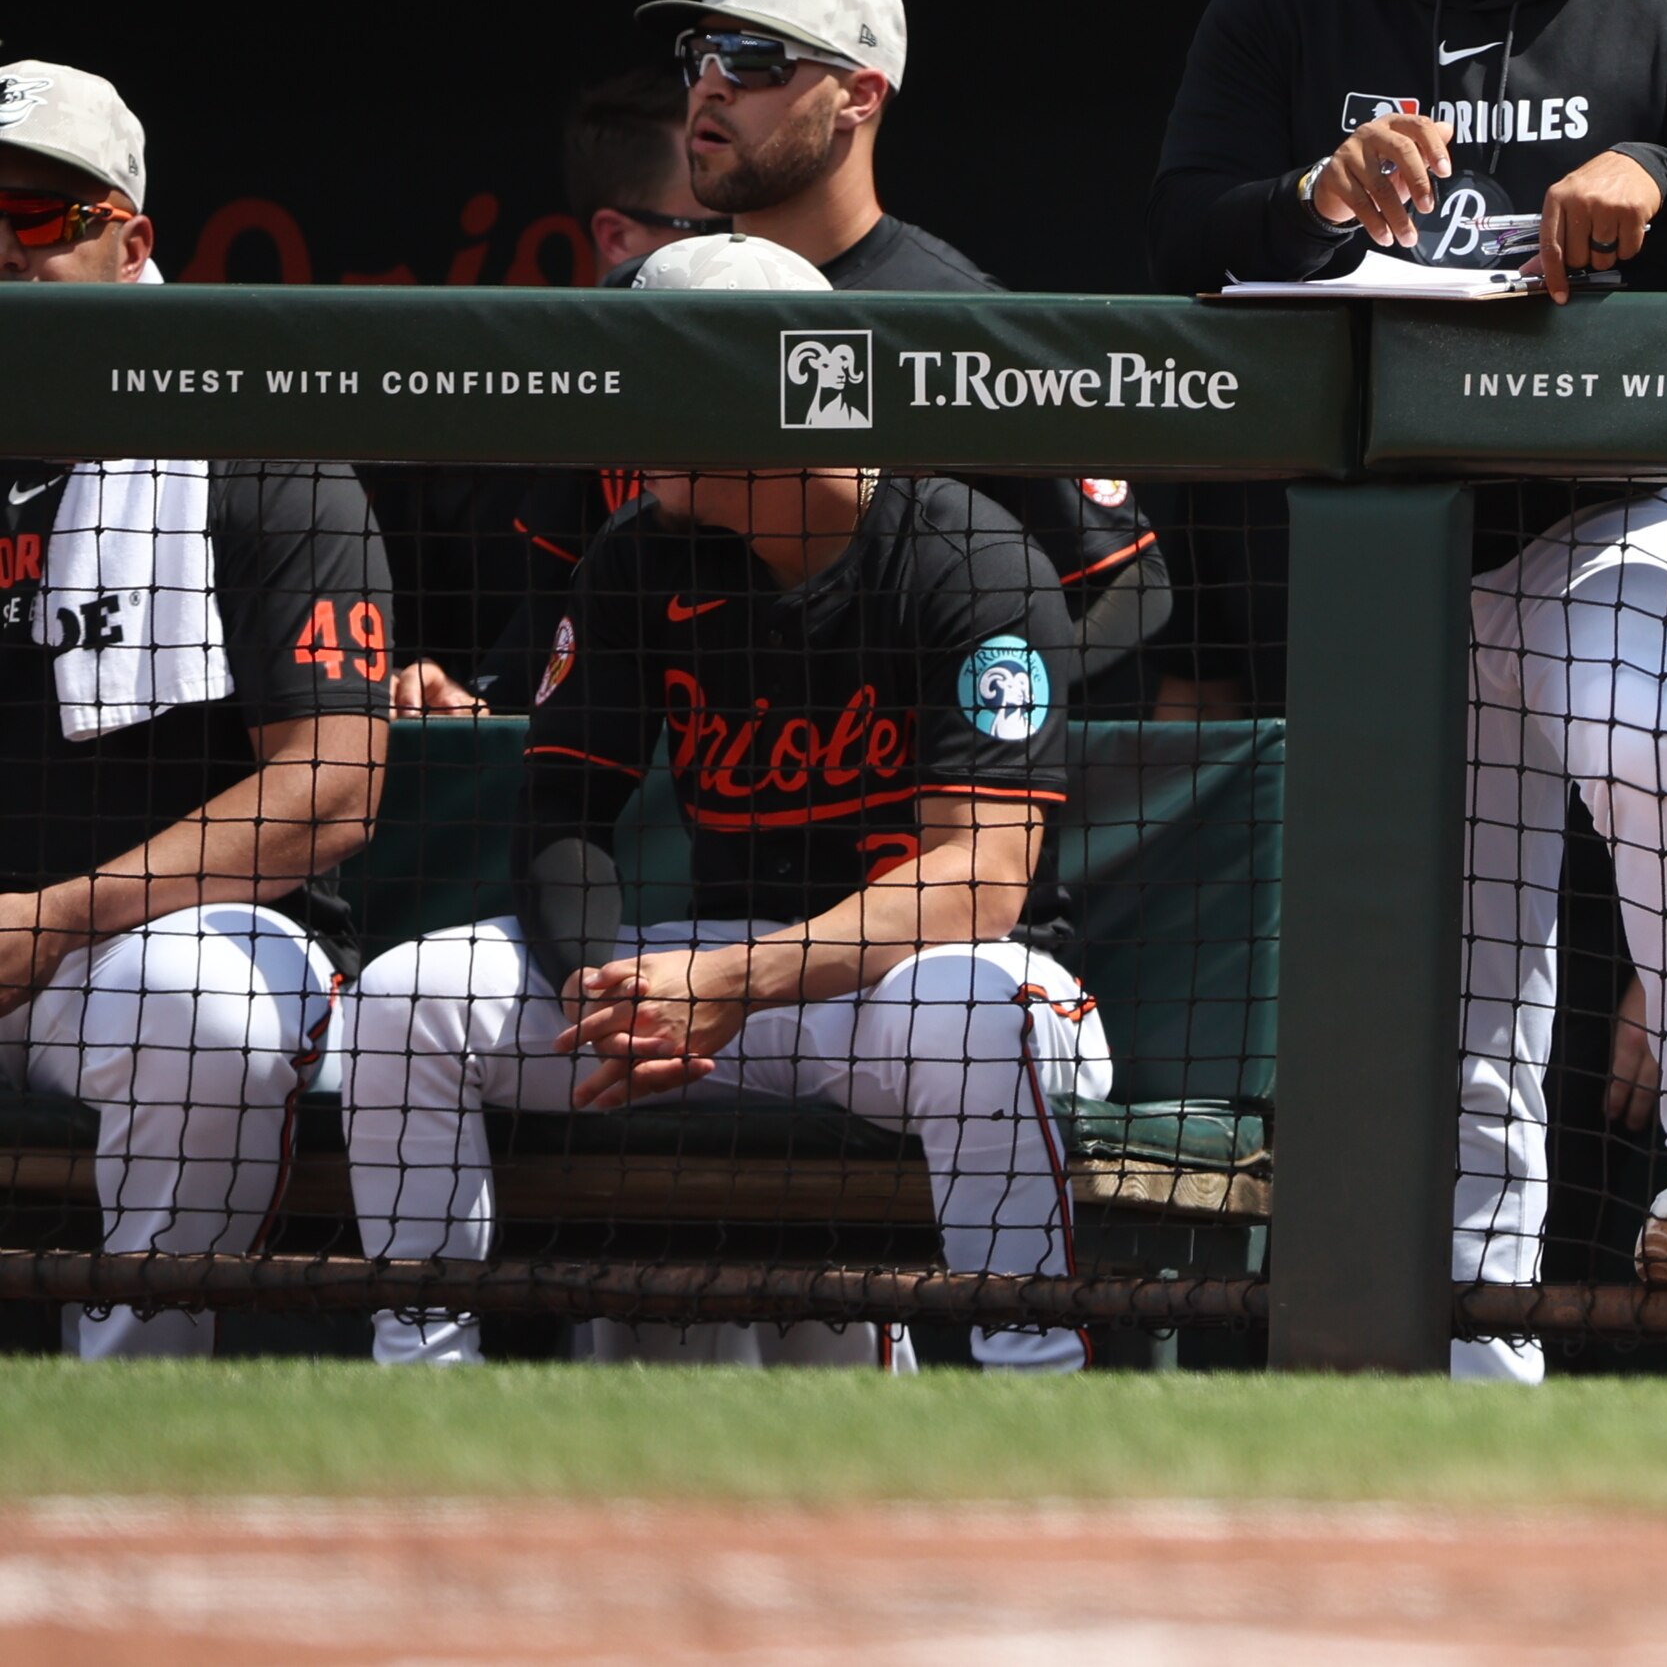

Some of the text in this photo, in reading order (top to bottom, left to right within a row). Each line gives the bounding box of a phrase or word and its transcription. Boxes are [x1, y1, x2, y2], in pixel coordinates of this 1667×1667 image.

[111, 368, 623, 398] INVEST WITH CONFIDENCE
[1463, 372, 1600, 398] INVEST
[293, 599, 387, 683] 49
